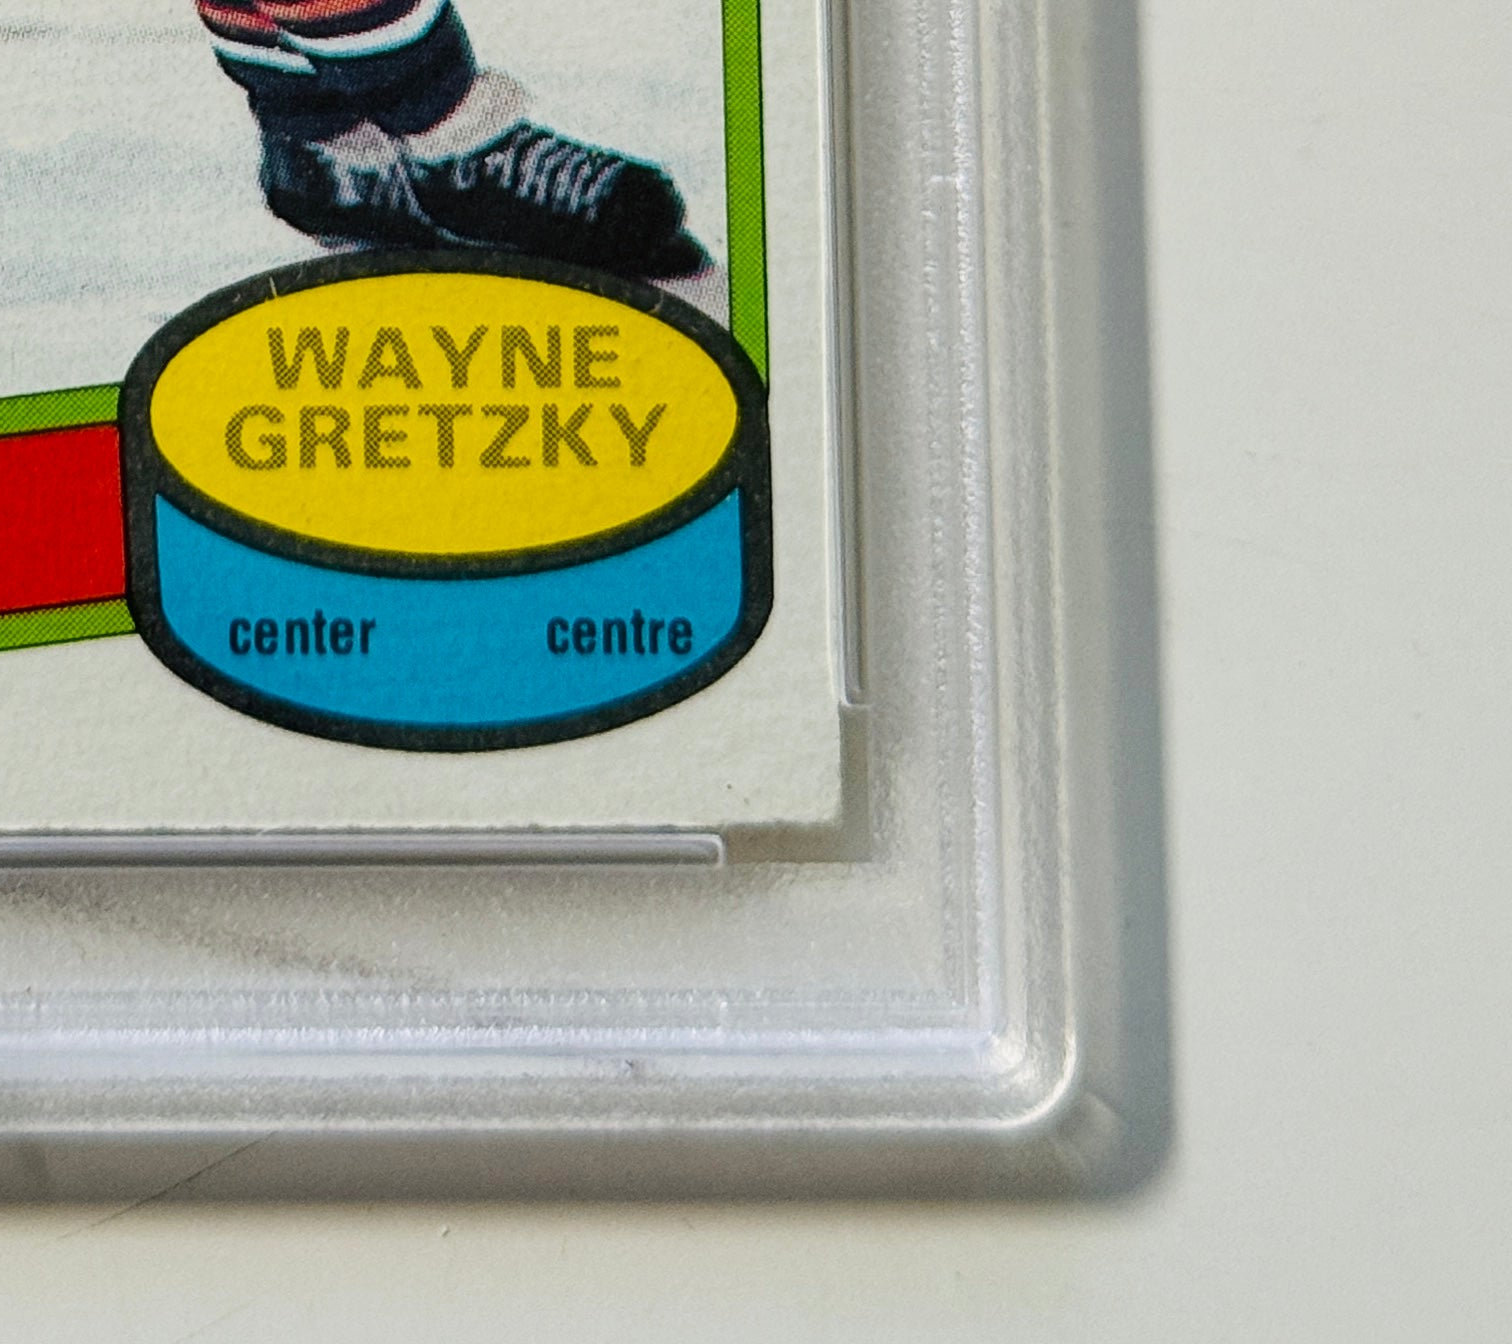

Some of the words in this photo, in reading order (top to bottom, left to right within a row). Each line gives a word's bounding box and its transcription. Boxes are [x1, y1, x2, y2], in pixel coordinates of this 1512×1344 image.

[266, 324, 622, 390] WAYNE
[224, 403, 668, 471] GRETZKY
[227, 609, 377, 656] center
[546, 608, 694, 656] centre
